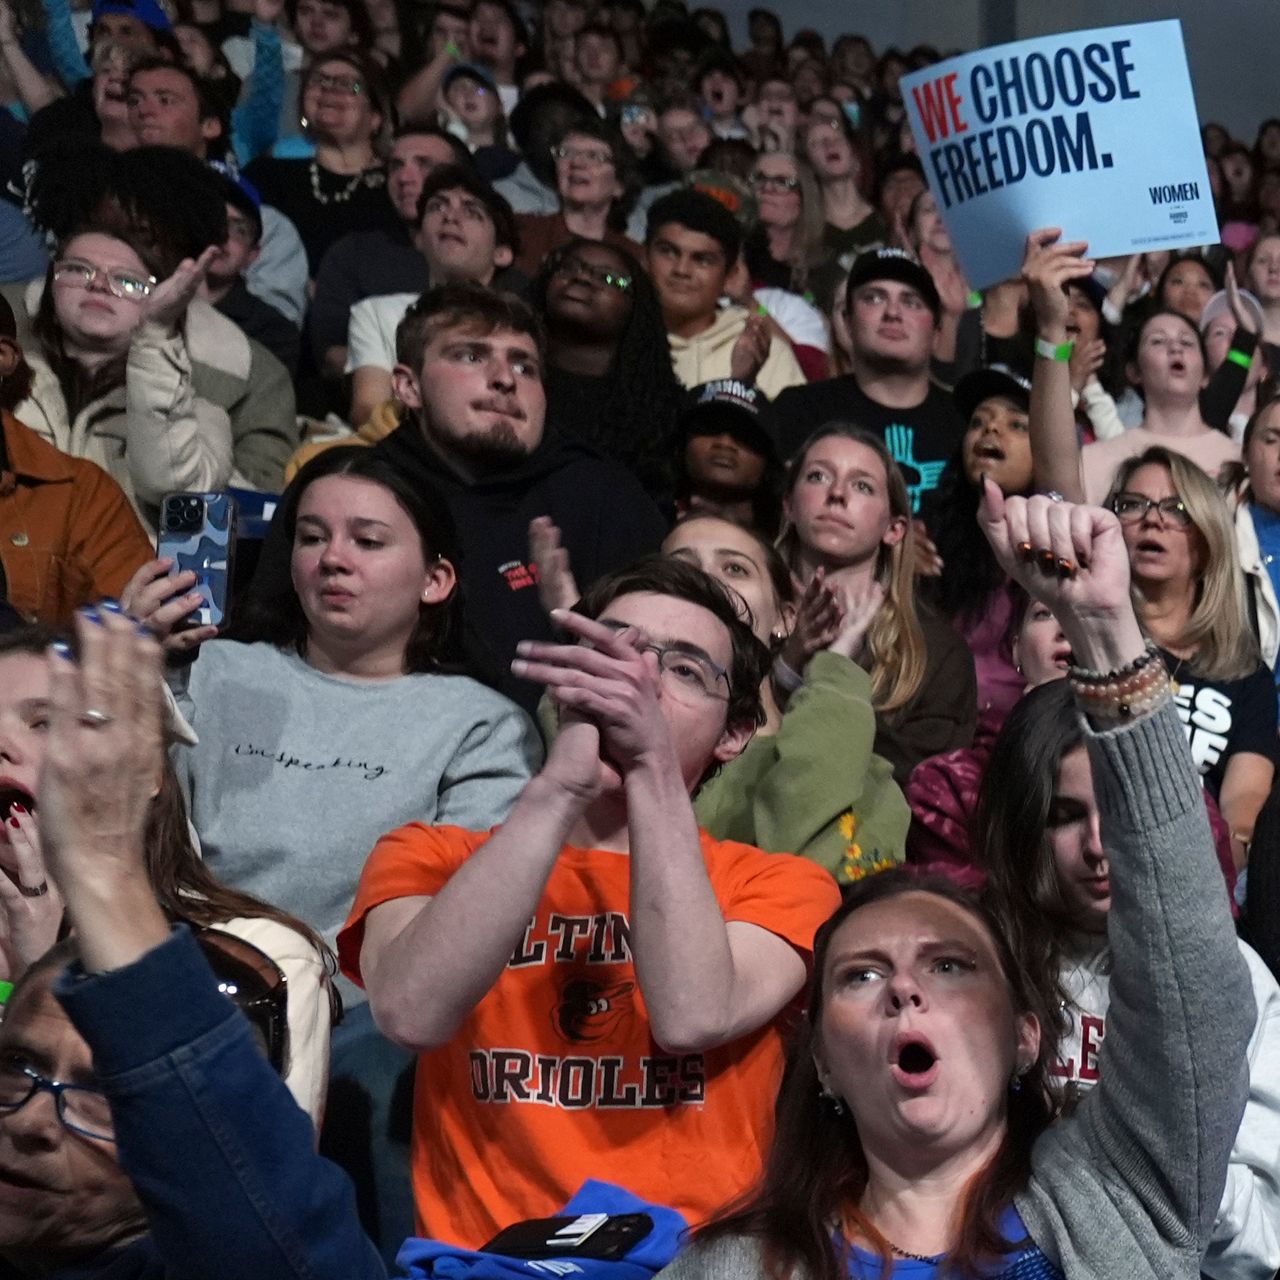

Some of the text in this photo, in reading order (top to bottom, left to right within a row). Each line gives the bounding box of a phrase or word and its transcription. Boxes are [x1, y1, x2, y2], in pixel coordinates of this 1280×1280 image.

[912, 40, 1141, 144] WE CHOOSE
[930, 111, 1114, 208] FREEDOM.
[1149, 182, 1200, 205] WOMEN
[469, 1048, 706, 1110] ORIOLES
